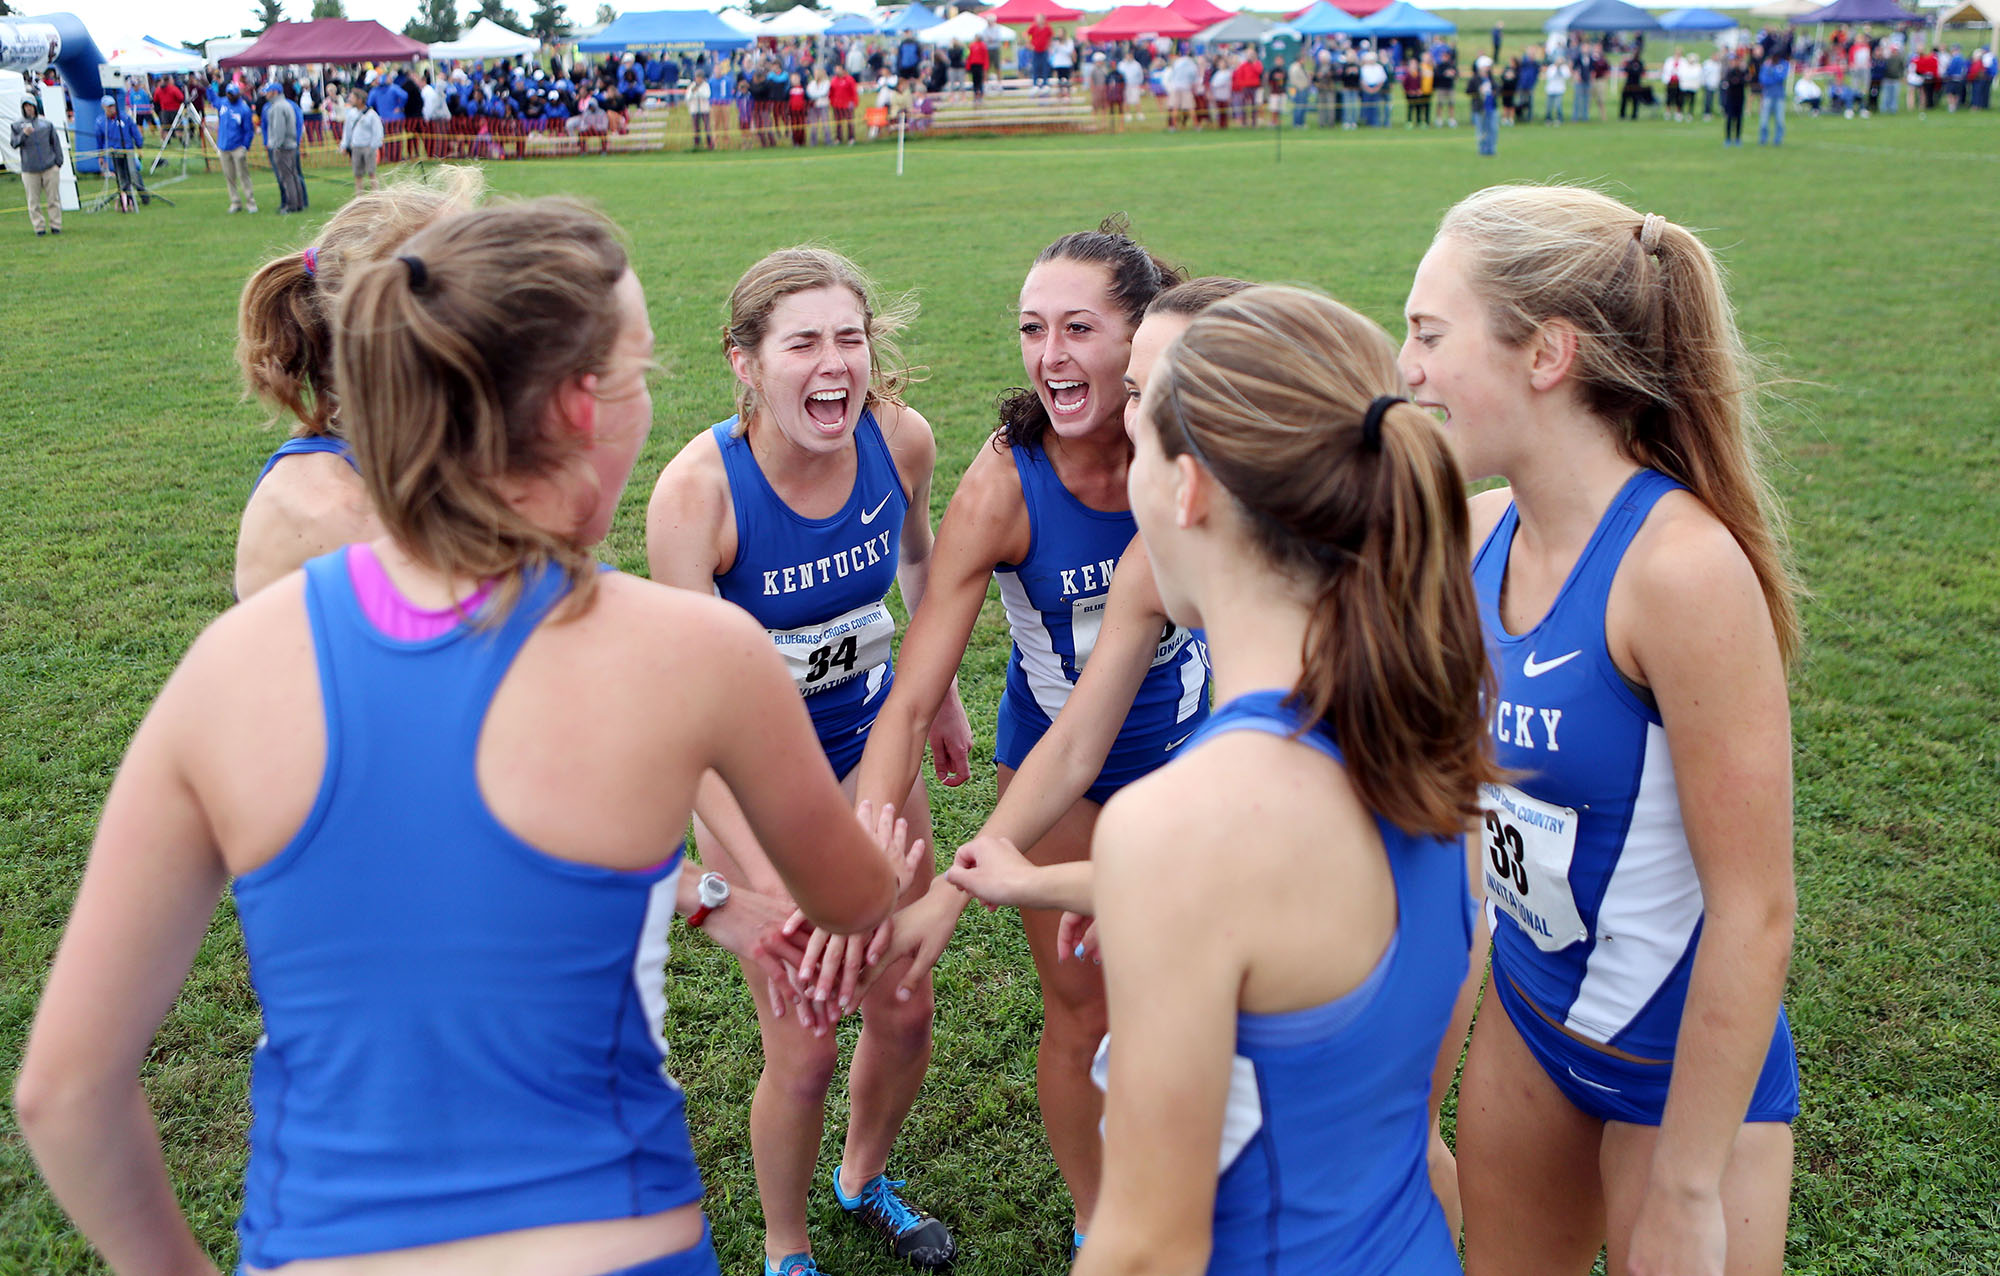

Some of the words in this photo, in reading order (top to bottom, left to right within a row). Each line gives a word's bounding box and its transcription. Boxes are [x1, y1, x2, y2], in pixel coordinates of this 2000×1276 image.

[763, 529, 891, 596] KENTUCKY
[1060, 558, 1123, 595] KEN
[774, 633, 822, 645] BLUEGRASS
[823, 622, 850, 640] CROSS
[850, 610, 884, 630] COUNTRY
[1083, 603, 1106, 613] BLUE
[805, 635, 858, 682] 34
[1497, 700, 1563, 752] CKY
[1517, 806, 1565, 834] COUNTRY
[1486, 810, 1529, 897] 33
[1486, 870, 1553, 938] INVITAONAL
